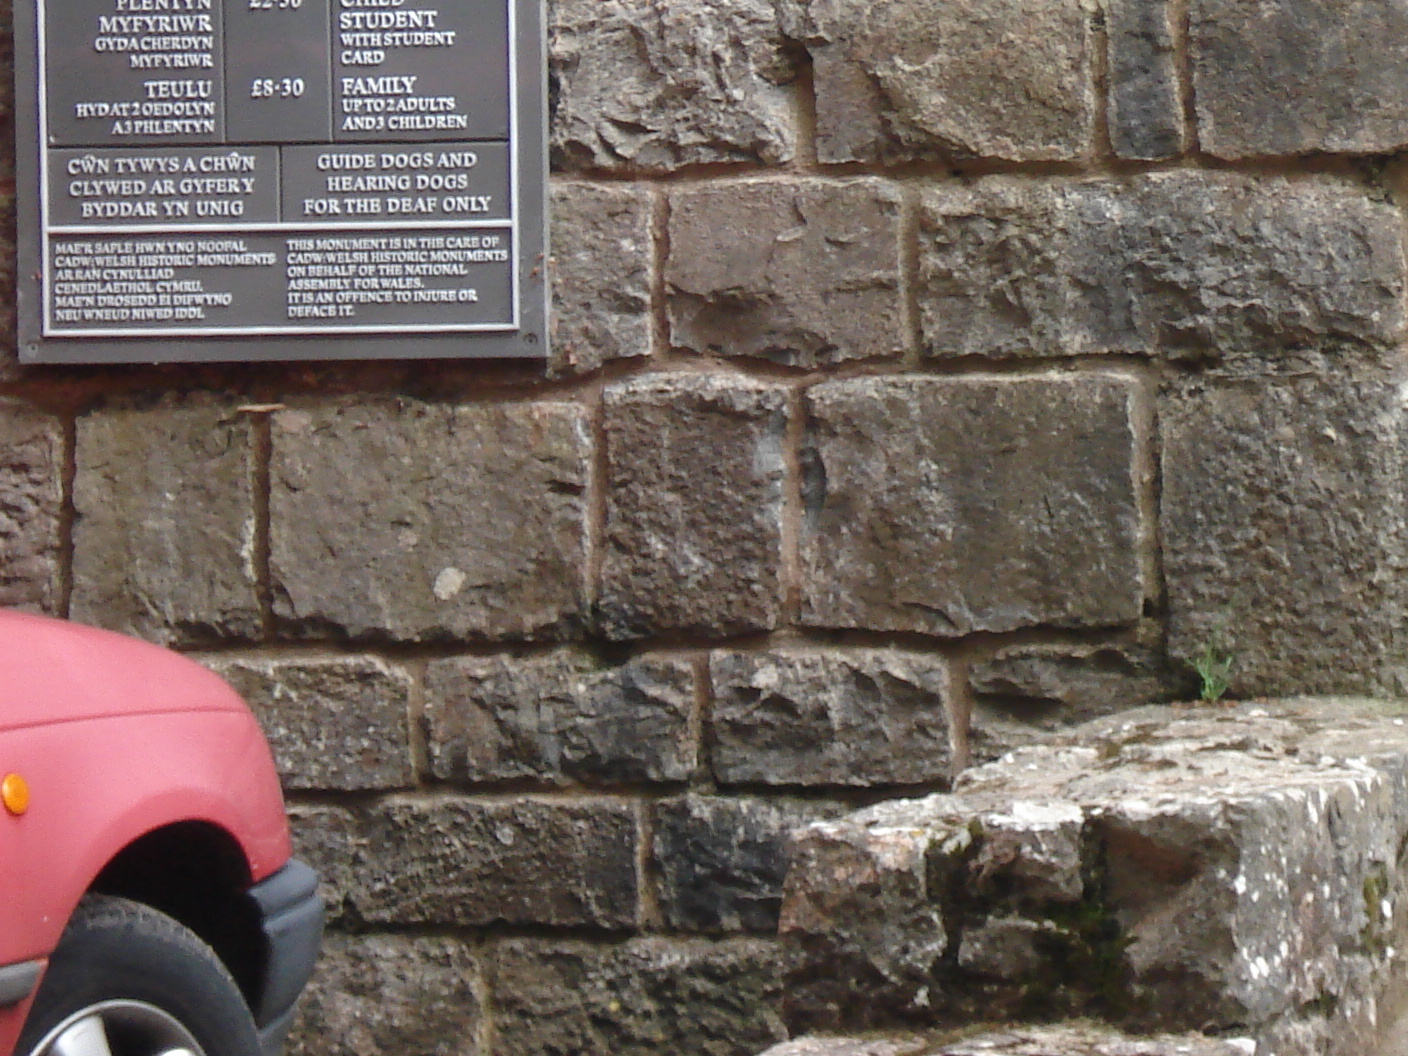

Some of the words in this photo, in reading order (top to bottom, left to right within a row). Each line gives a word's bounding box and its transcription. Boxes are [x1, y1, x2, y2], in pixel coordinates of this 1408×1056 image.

[99, 15, 213, 33] MYFYRIWR
[340, 11, 437, 29] STUDENT
[340, 33, 383, 46] WITH
[384, 31, 455, 45] STUDENT
[130, 54, 213, 68] MYFYRIWR
[342, 50, 384, 65] CARD
[144, 81, 213, 98] TEULU
[342, 76, 417, 95] FAMILY
[142, 102, 215, 116] OEDOLYN
[343, 98, 362, 113] UP
[365, 98, 385, 112] TO
[397, 97, 456, 111] ADULTS
[134, 119, 215, 134] PHLENTYN
[342, 117, 376, 131] AND
[388, 115, 468, 129] CHILDREN
[114, 158, 179, 173] TYWYS
[317, 154, 376, 170] GUIDE
[381, 153, 433, 168] DOGS
[437, 152, 477, 168] AND
[70, 180, 146, 196] CLYWED
[150, 180, 175, 194] AR
[179, 179, 240, 194] GYFER
[327, 176, 410, 191] HEARING
[417, 174, 468, 190] DOGS
[82, 202, 158, 217] BYDDAR
[163, 202, 189, 216] YN
[196, 201, 244, 216] UNIG
[304, 199, 341, 215] FOR
[344, 198, 381, 213] THE
[387, 197, 437, 213] DEAF
[442, 196, 492, 212] ONLY
[287, 239, 314, 251] THIS
[316, 239, 386, 250] MONUMENT
[418, 238, 444, 249] THE
[446, 237, 479, 248] CARE
[482, 237, 499, 248] OF
[371, 252, 428, 263] HISTORIC
[430, 250, 508, 262] MONUMENTS
[287, 266, 305, 278] ON
[308, 266, 356, 277] BEHALF
[359, 265, 376, 276] OF
[378, 265, 403, 276] THE
[405, 264, 468, 275] NATIONAL
[288, 279, 351, 291] ASSEMBLY
[354, 279, 379, 289] FOR
[316, 293, 333, 303] AN
[336, 292, 392, 303] OFFENCE
[395, 291, 412, 302] TO
[414, 291, 456, 302] INJURE
[459, 290, 478, 301] OR
[288, 307, 337, 317] DEFACE
